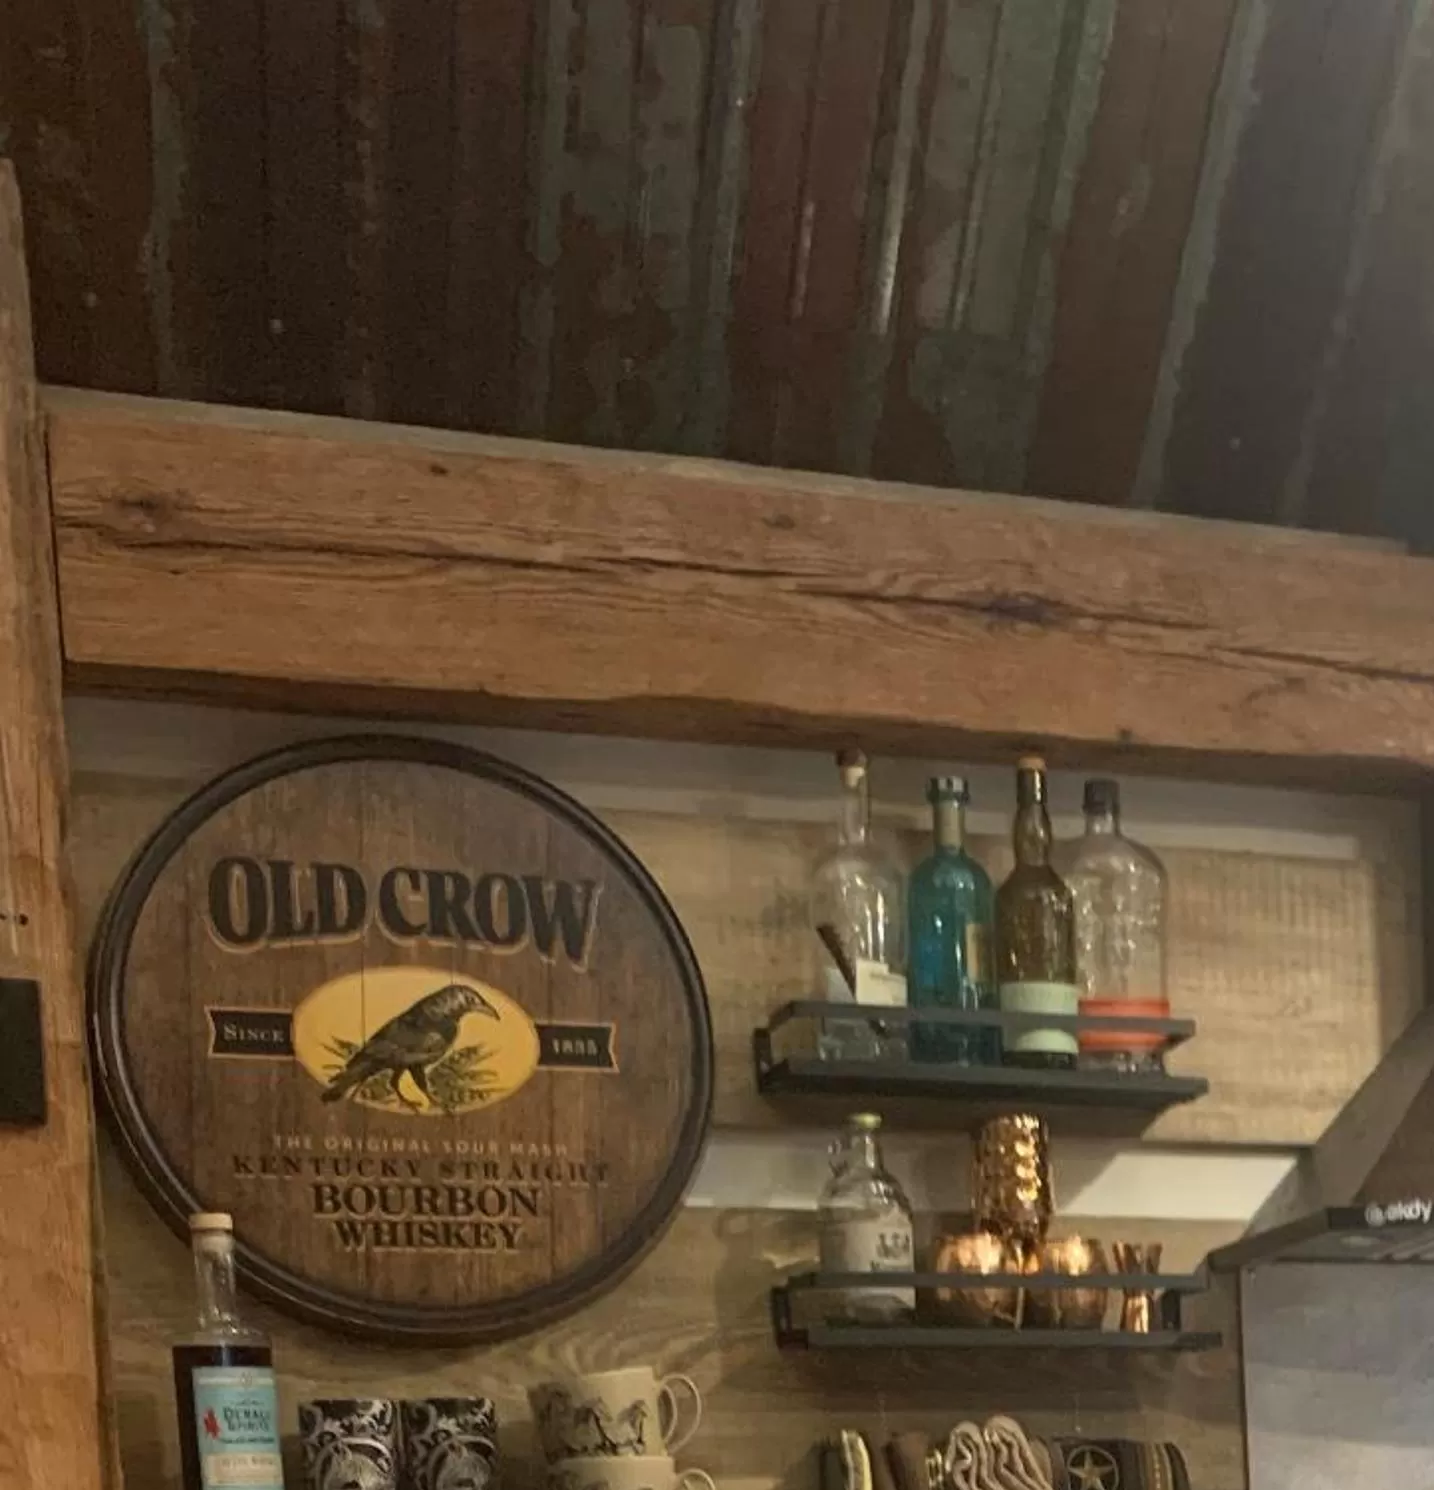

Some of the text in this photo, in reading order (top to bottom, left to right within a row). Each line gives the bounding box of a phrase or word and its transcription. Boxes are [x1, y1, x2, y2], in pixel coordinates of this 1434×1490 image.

[207, 856, 602, 972] OLD CROW
[273, 1135, 568, 1156] THE ORIGINAL SOUR MASH
[233, 1154, 611, 1187] KENTUCKY STRAIGHT
[312, 1182, 542, 1218] BOURBON
[333, 1217, 524, 1253] WHISKEY
